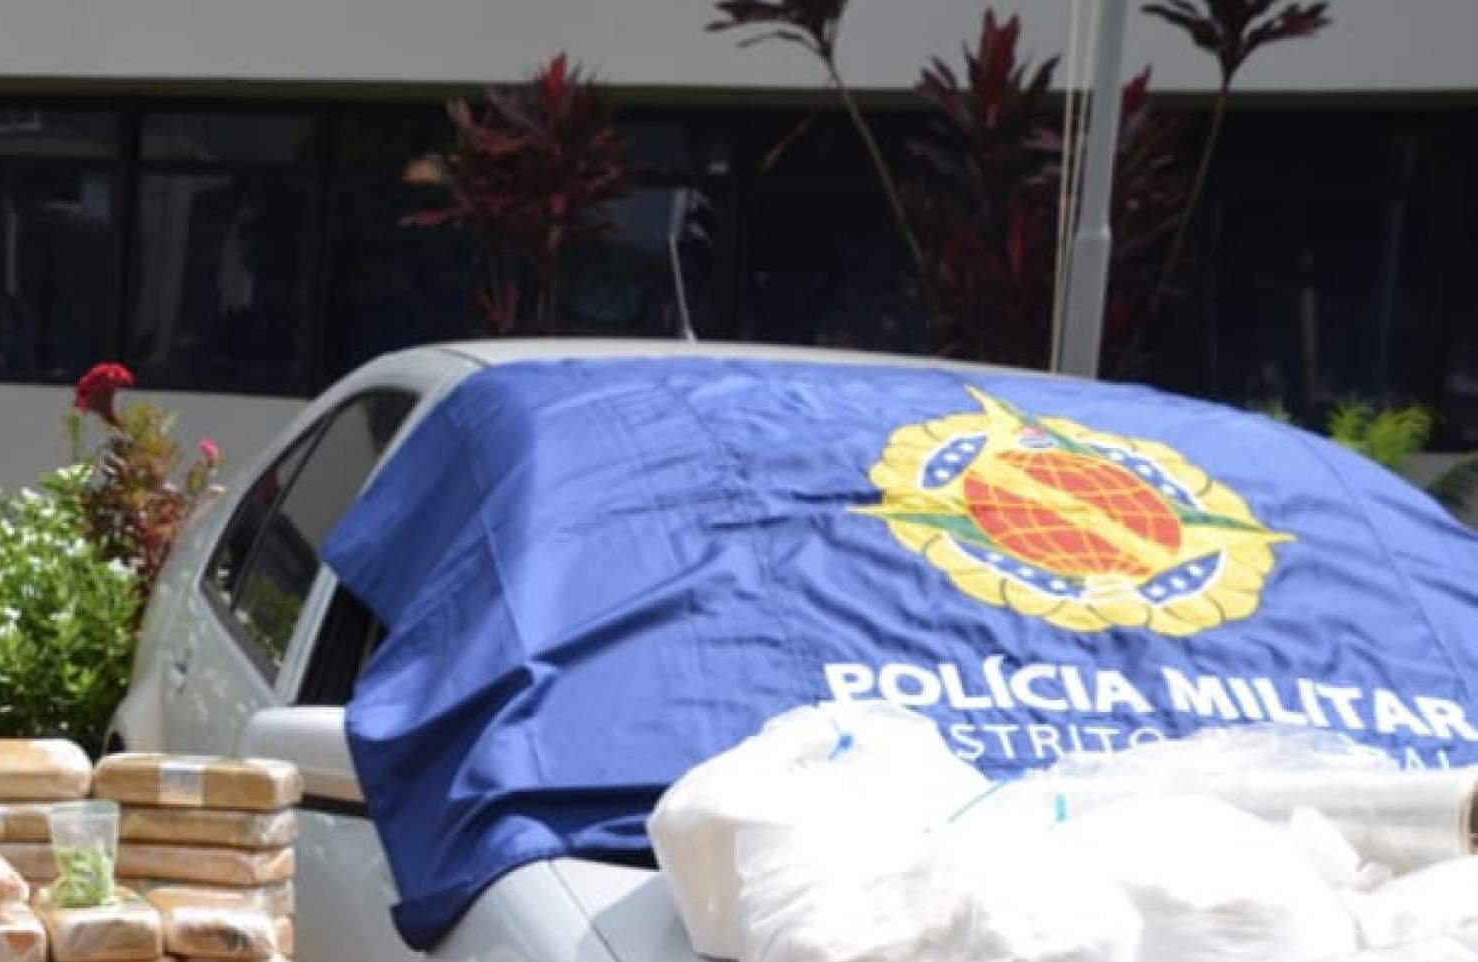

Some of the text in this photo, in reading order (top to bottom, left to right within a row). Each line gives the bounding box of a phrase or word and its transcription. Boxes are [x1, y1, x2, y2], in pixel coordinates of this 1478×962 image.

[824, 654, 1478, 741] POLÍCIA MILITAR
[949, 724, 1166, 760] STRITO
